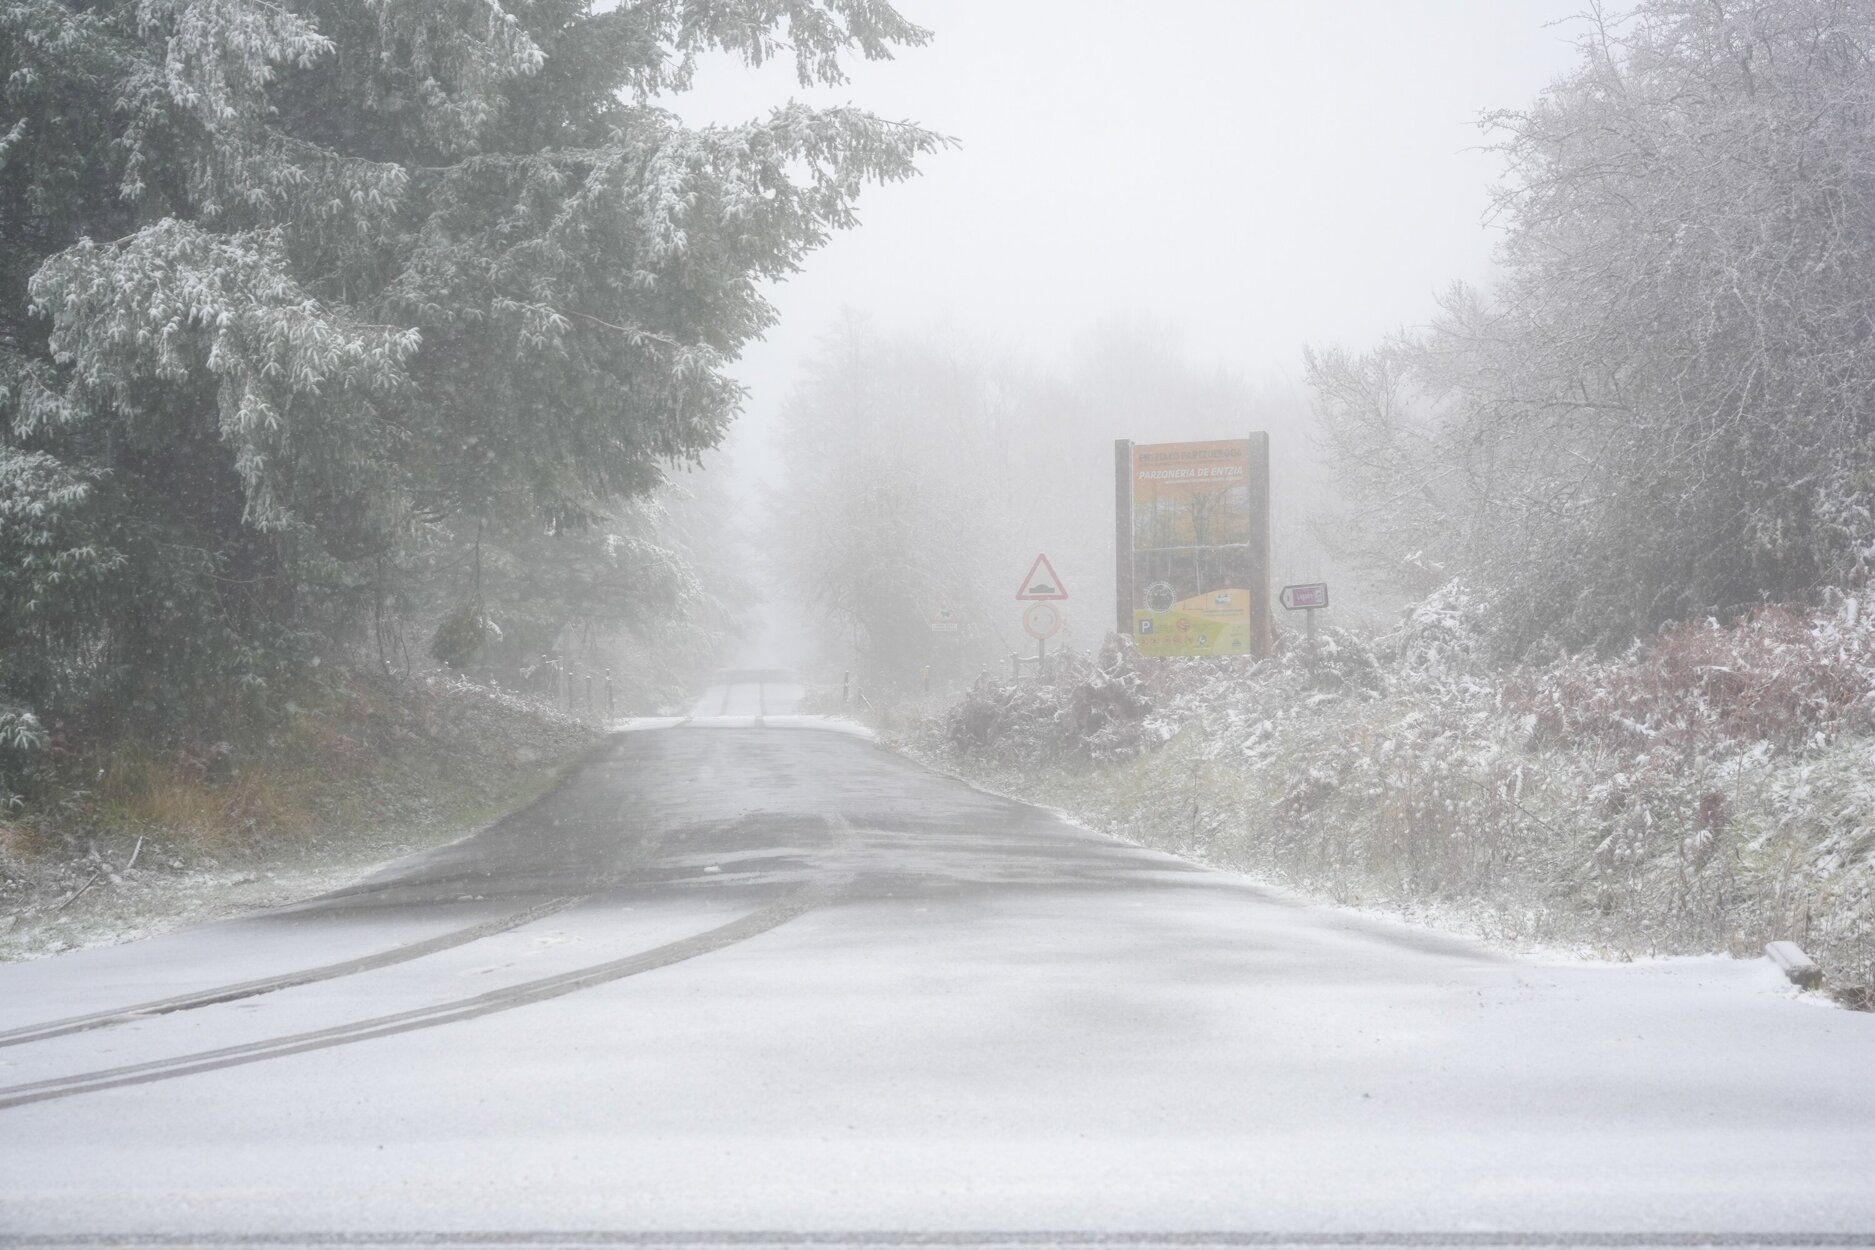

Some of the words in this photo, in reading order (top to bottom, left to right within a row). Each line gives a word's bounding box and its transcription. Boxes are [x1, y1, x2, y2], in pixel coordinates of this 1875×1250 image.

[1197, 467, 1209, 477] DE
[1211, 465, 1243, 477] ENTZIA
[1141, 621, 1150, 632] P
